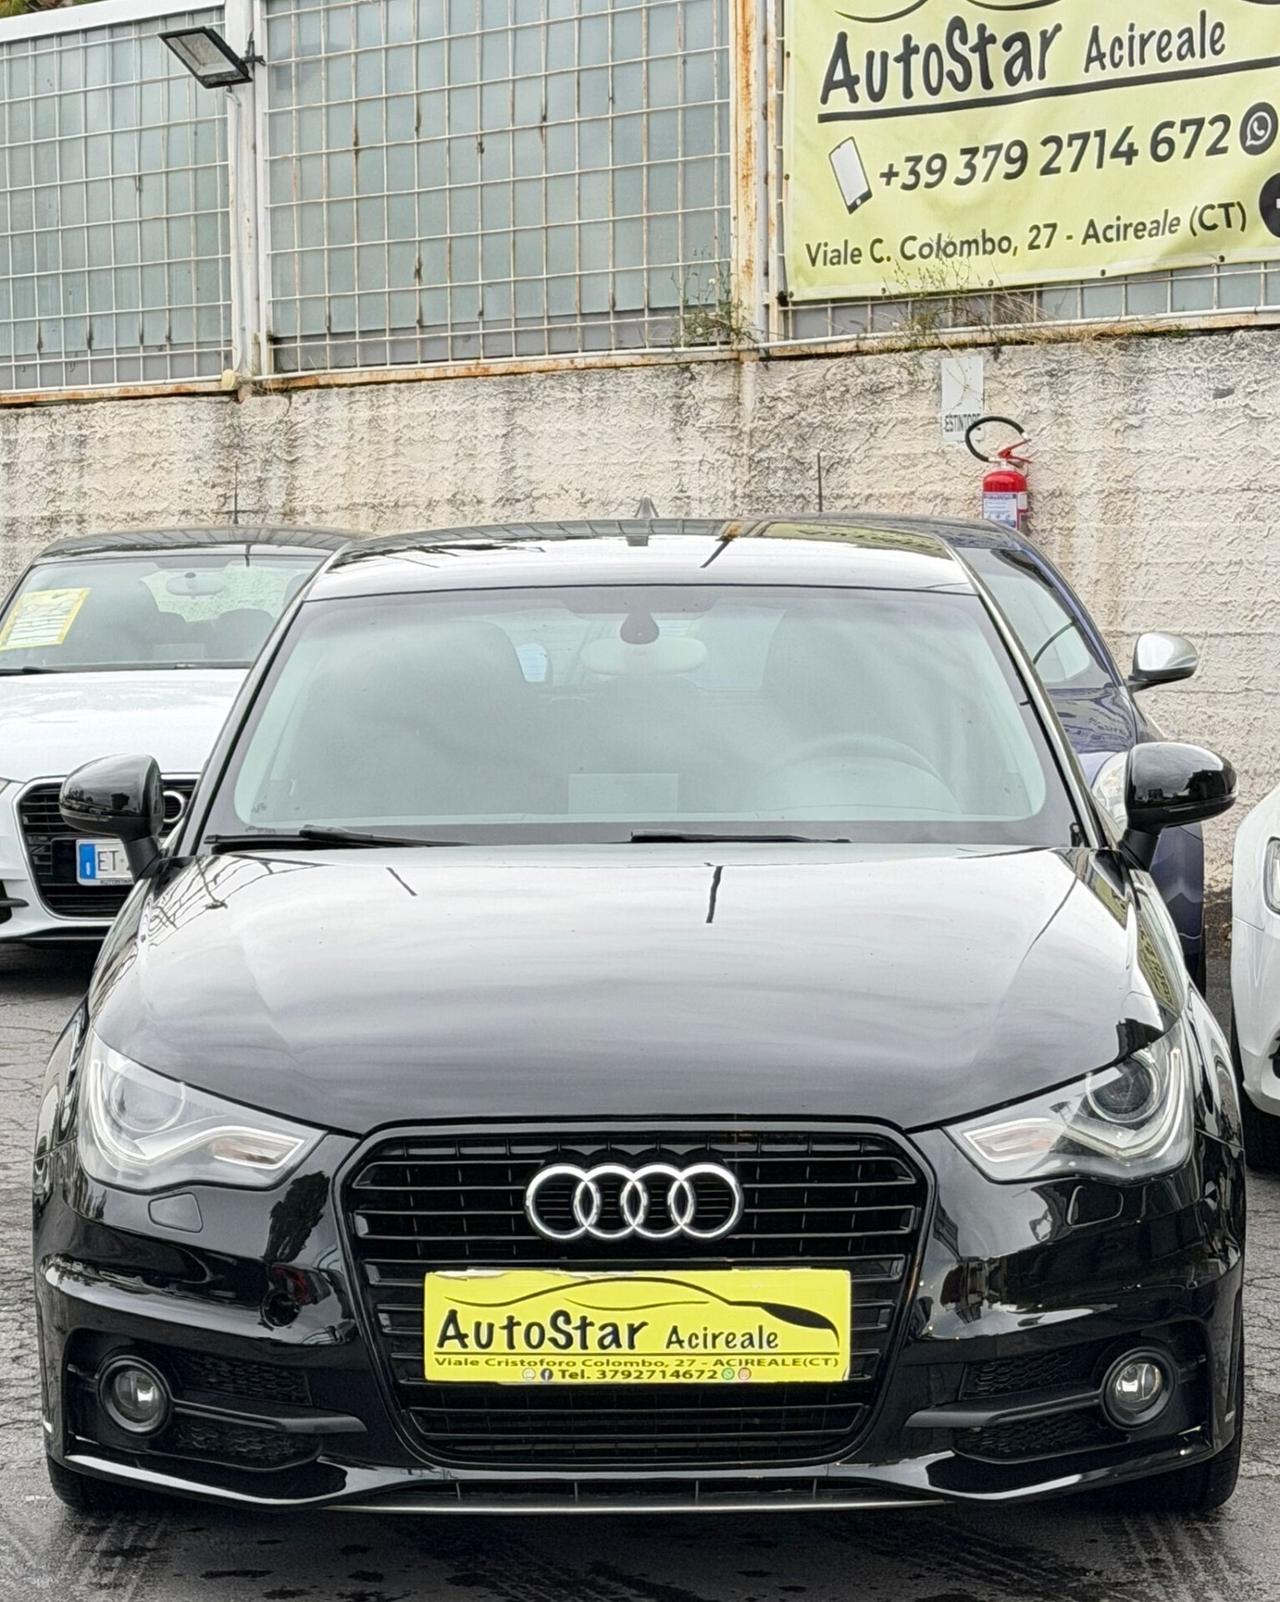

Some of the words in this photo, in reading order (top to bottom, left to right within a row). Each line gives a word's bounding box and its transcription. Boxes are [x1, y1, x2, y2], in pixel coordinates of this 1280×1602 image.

[819, 15, 1063, 105] AutoStar
[1083, 9, 1226, 73] Acireale
[879, 152, 948, 191] +39
[952, 139, 1028, 186] 379
[1039, 126, 1139, 176] 2714
[1150, 113, 1231, 163] 672
[805, 239, 863, 267] Viale
[869, 237, 892, 264] C.
[899, 228, 1019, 261] Colombo,
[1027, 223, 1058, 251] 27
[1081, 208, 1181, 246] Acireale
[1189, 200, 1248, 237] (CT)
[436, 1308, 650, 1351] AutoStar
[665, 1325, 779, 1350] Acireale
[434, 1357, 480, 1368] Viale
[484, 1357, 577, 1368] Cristoforo
[581, 1357, 670, 1369] Colombo,
[675, 1358, 698, 1368] 27
[712, 1357, 840, 1368] ACIREALE(CT)
[557, 1369, 592, 1380] Tel.
[596, 1369, 719, 1380] 3792714672
